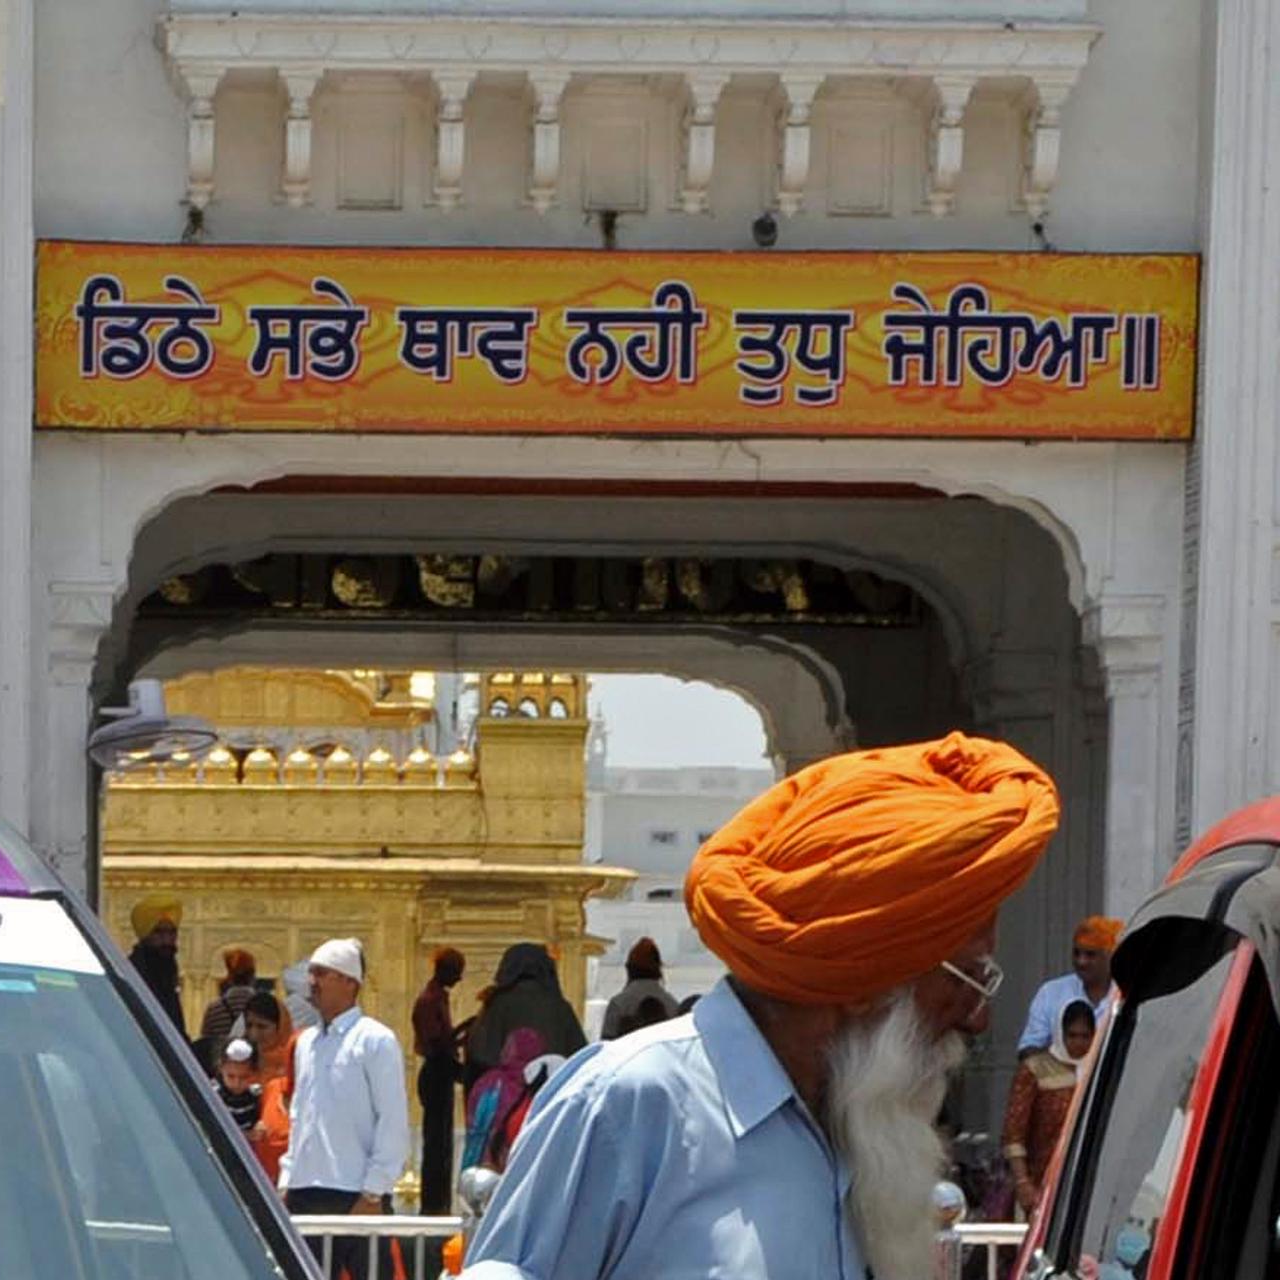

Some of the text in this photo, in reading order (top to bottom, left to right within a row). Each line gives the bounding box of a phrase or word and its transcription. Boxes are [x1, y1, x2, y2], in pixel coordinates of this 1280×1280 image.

[76, 275, 217, 377] ਡਿਠੇ
[249, 277, 366, 378] ਸਭੇ
[566, 284, 702, 383] ਨਹੀ
